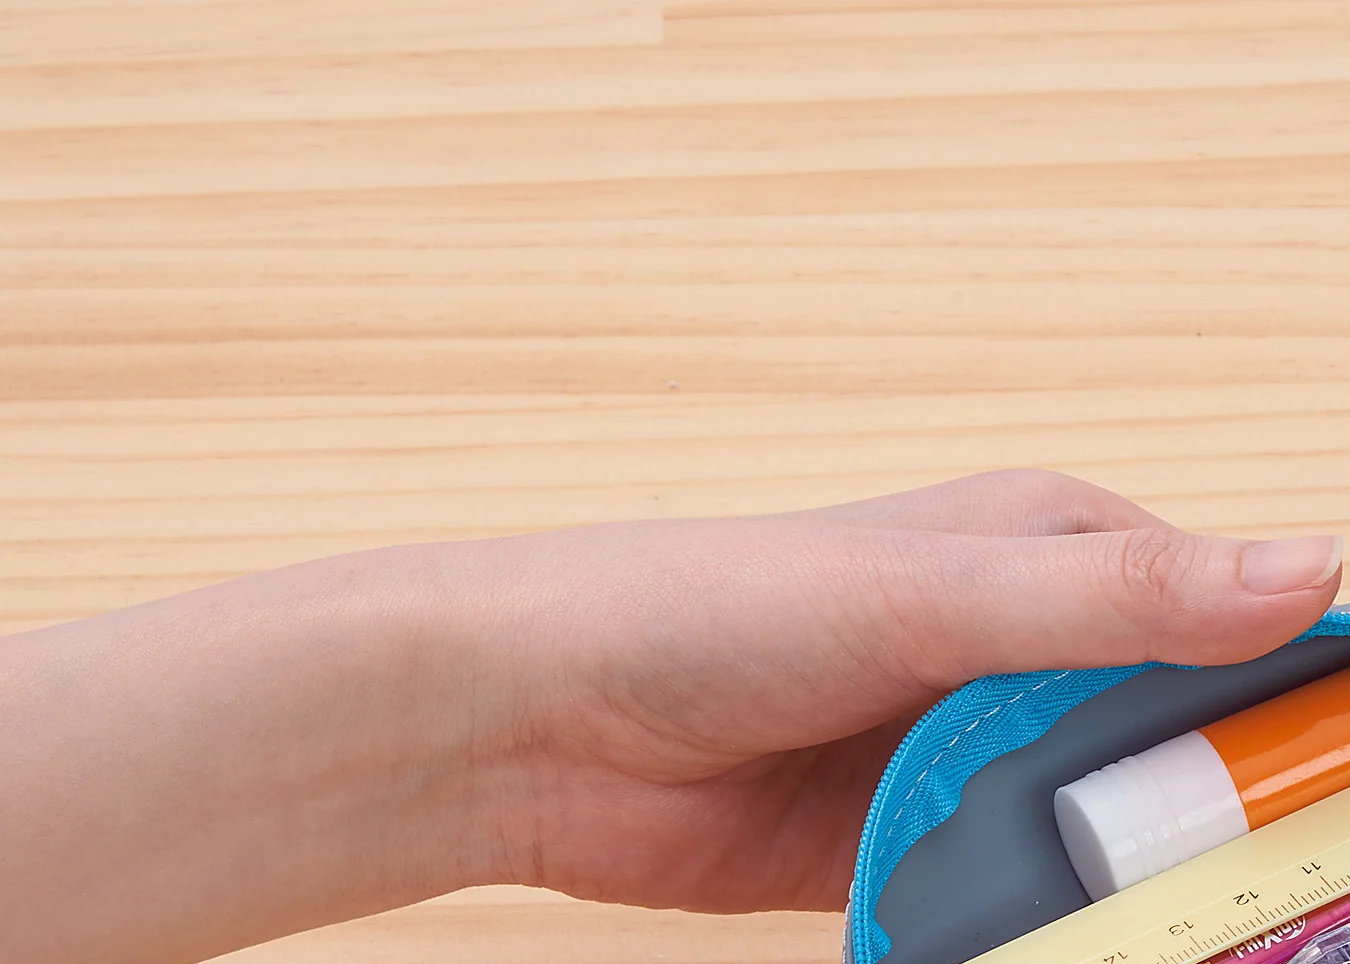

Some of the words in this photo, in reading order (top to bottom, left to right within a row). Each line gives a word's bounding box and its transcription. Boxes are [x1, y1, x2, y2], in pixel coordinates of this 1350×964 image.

[1300, 862, 1322, 876] 11
[1233, 890, 1260, 906] 12
[1168, 921, 1195, 937] 13
